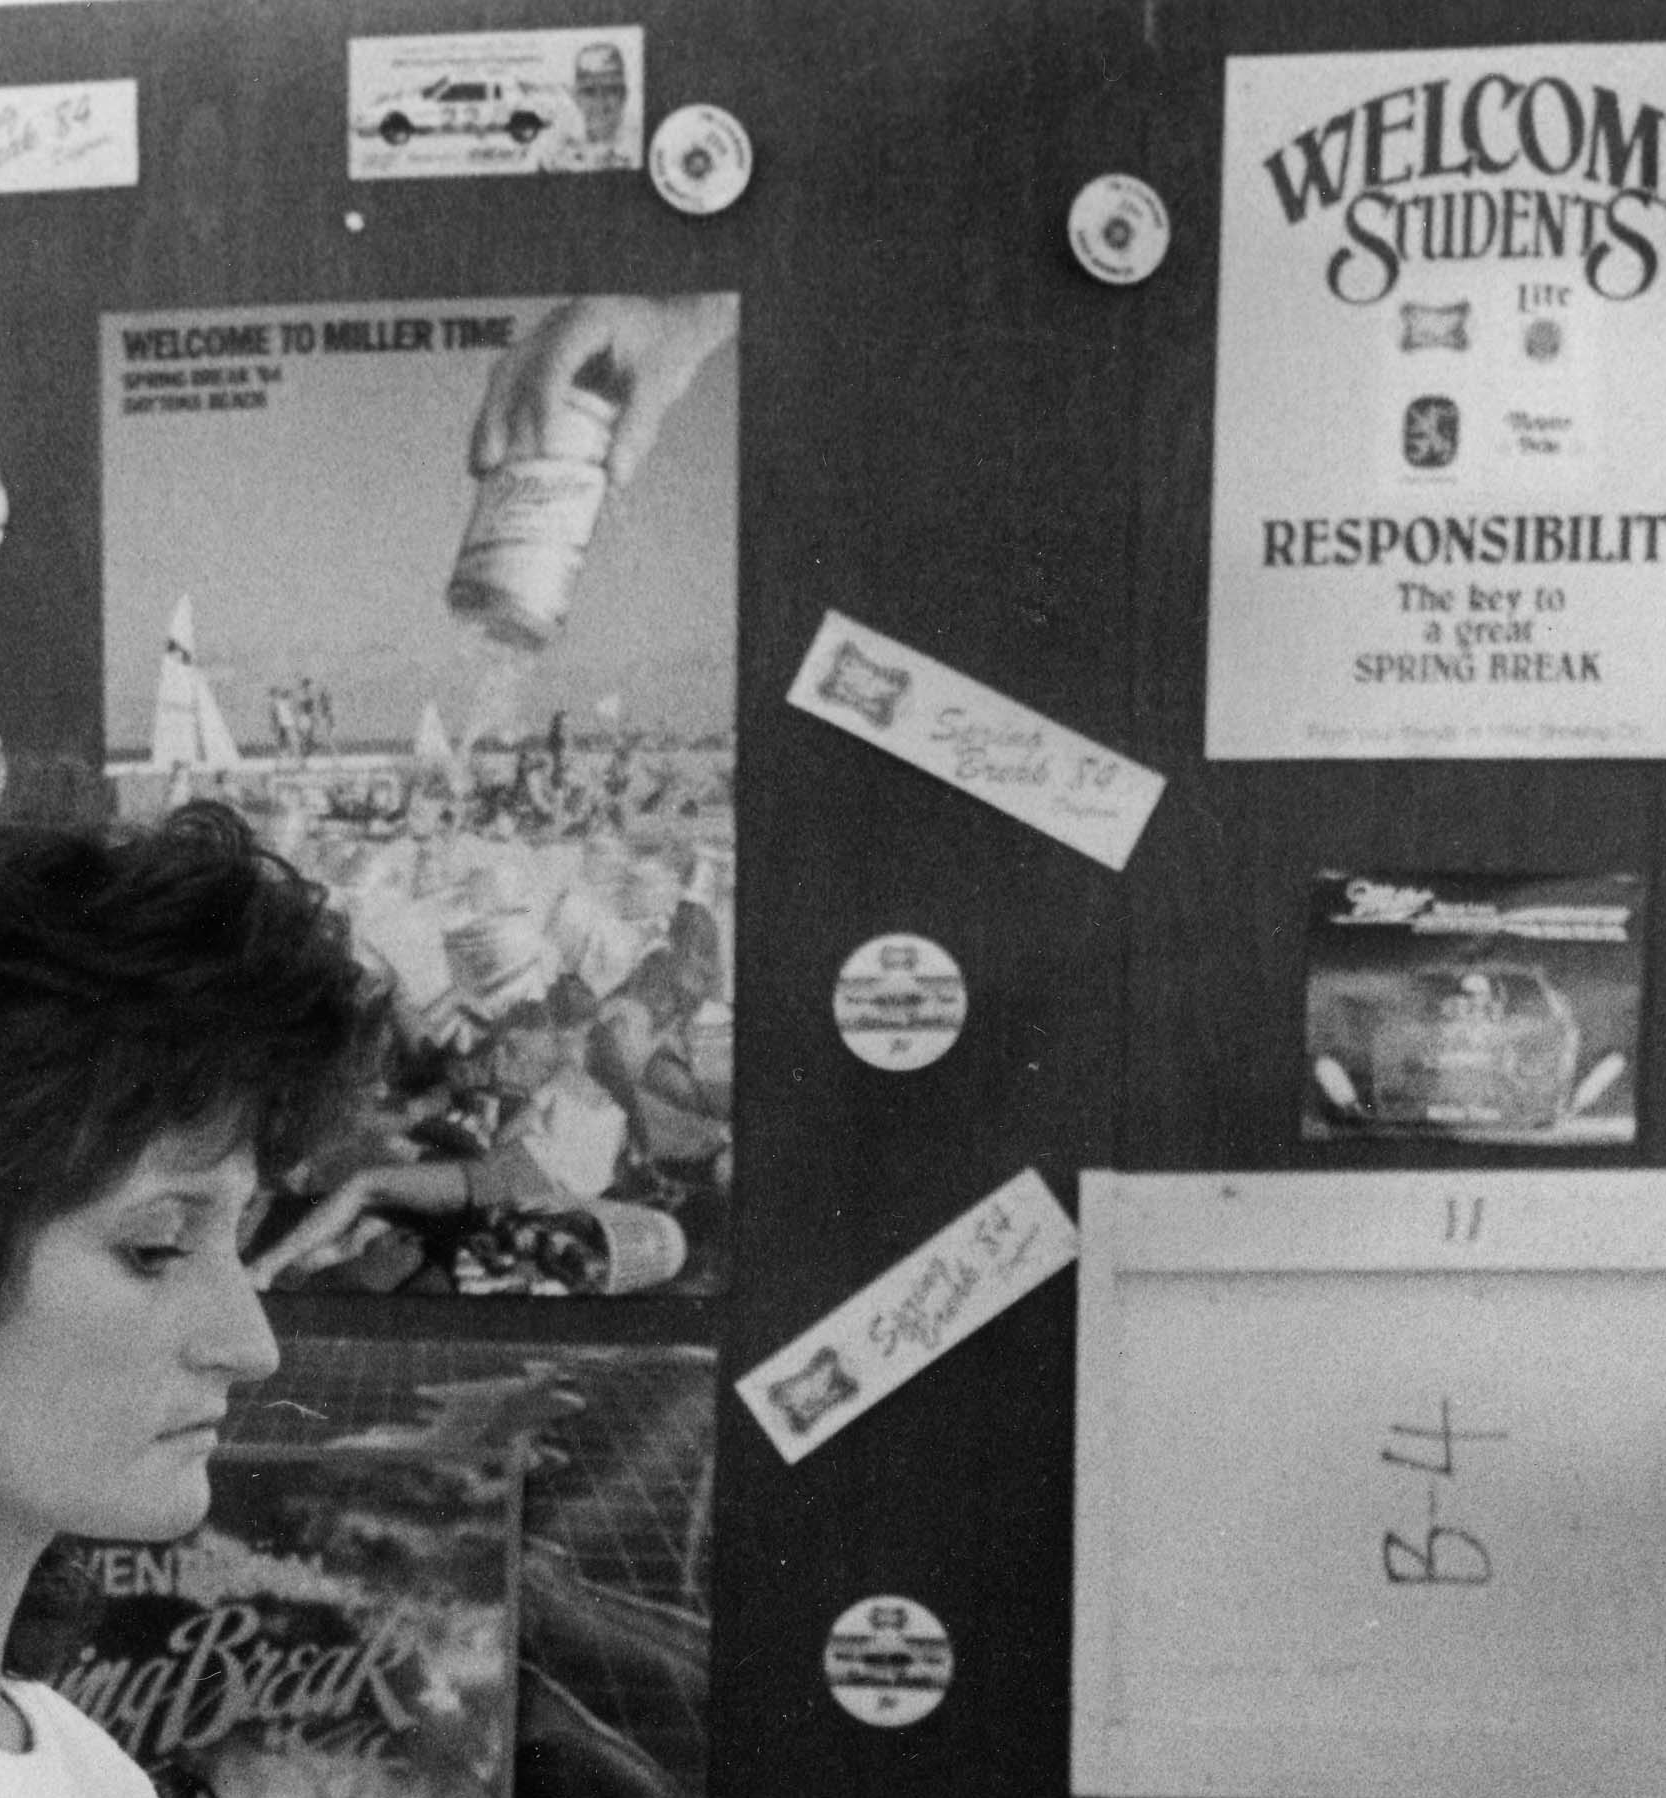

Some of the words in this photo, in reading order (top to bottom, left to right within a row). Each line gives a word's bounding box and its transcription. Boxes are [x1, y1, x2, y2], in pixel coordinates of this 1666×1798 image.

[1325, 188, 1659, 305] STUDENTS
[122, 322, 271, 361] WELCOME
[279, 320, 316, 354] TO
[324, 316, 433, 353] MILLER
[439, 314, 516, 350] TIME
[1397, 582, 1454, 613] The
[1467, 582, 1523, 619] key
[1533, 586, 1566, 613] to
[1423, 619, 1443, 645] a
[1454, 618, 1536, 653] great
[1353, 652, 1476, 683] SPRING
[1489, 650, 1603, 683] BREAK
[1381, 1399, 1510, 1585] B-4
[155, 1608, 420, 1760] Break
